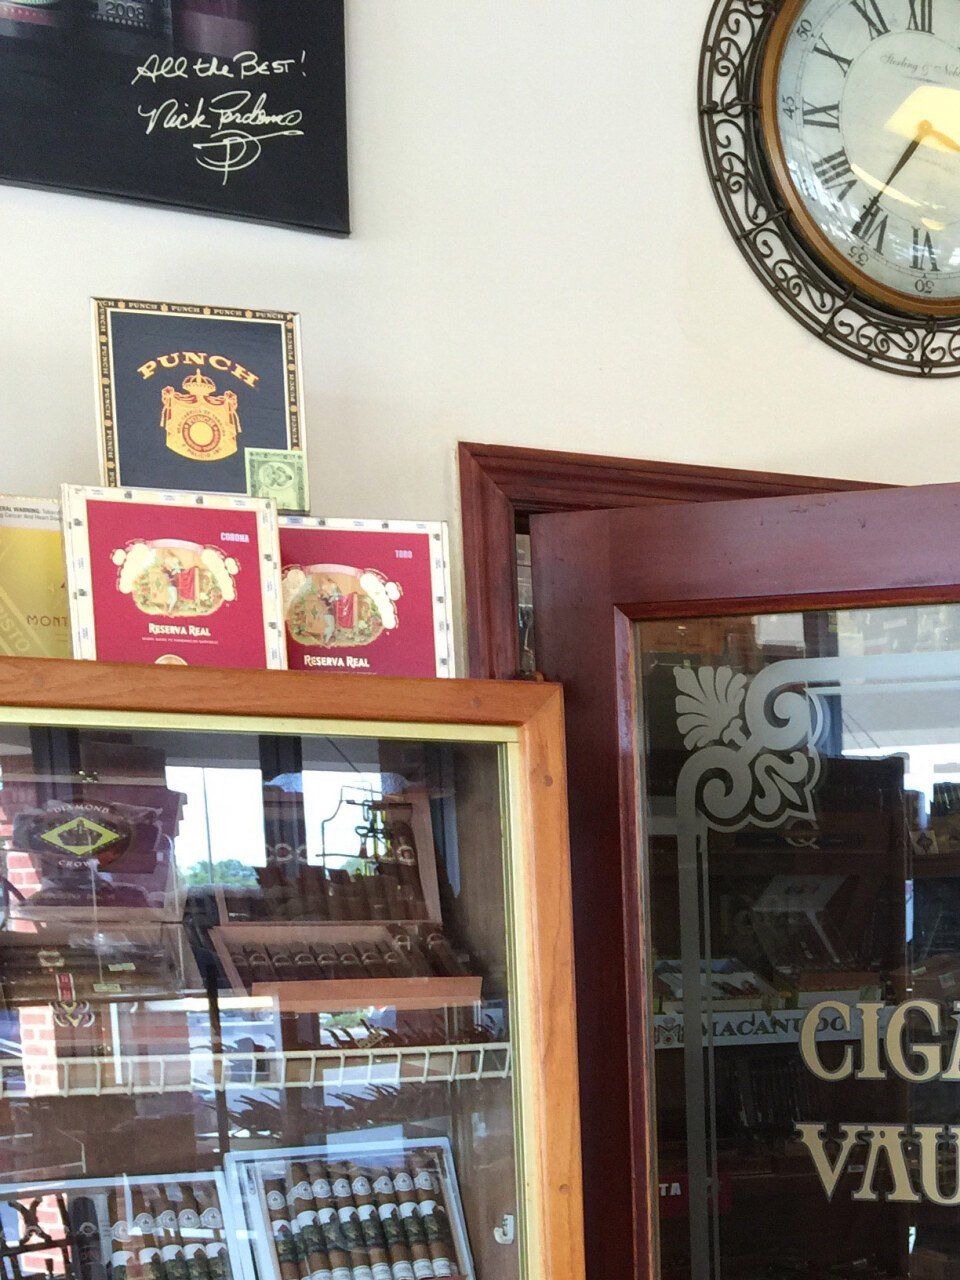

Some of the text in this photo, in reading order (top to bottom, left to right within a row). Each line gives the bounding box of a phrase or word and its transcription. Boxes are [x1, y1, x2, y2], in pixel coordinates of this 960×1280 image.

[131, 53, 188, 85] All
[193, 58, 234, 77] the
[138, 98, 211, 135] Nick
[128, 302, 285, 320] PUNCH PUNCH PUNCH PUNCH
[137, 351, 260, 388] PUNCH
